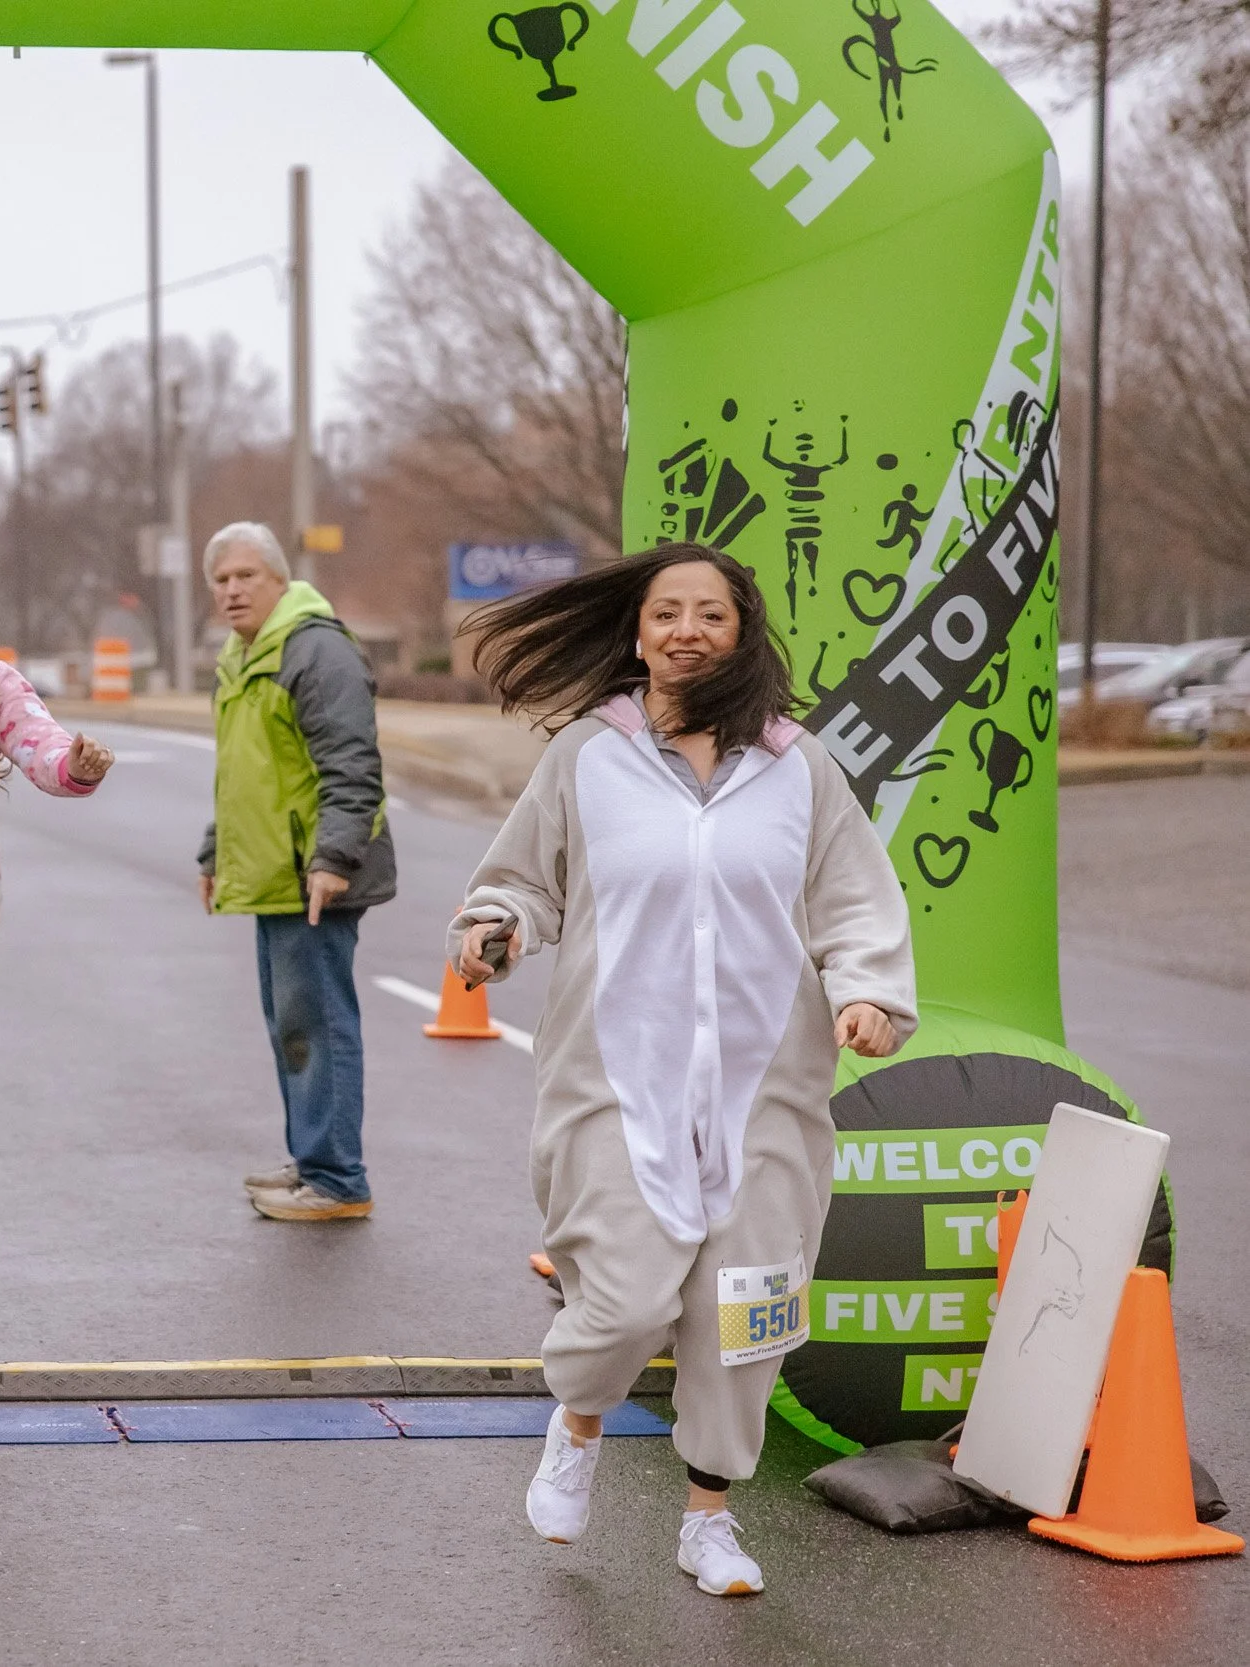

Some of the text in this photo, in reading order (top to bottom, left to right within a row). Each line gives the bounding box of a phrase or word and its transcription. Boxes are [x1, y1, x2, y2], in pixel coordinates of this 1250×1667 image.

[878, 594, 988, 702] TO
[749, 1295, 800, 1342] 550
[825, 1292, 965, 1331] FIVE
